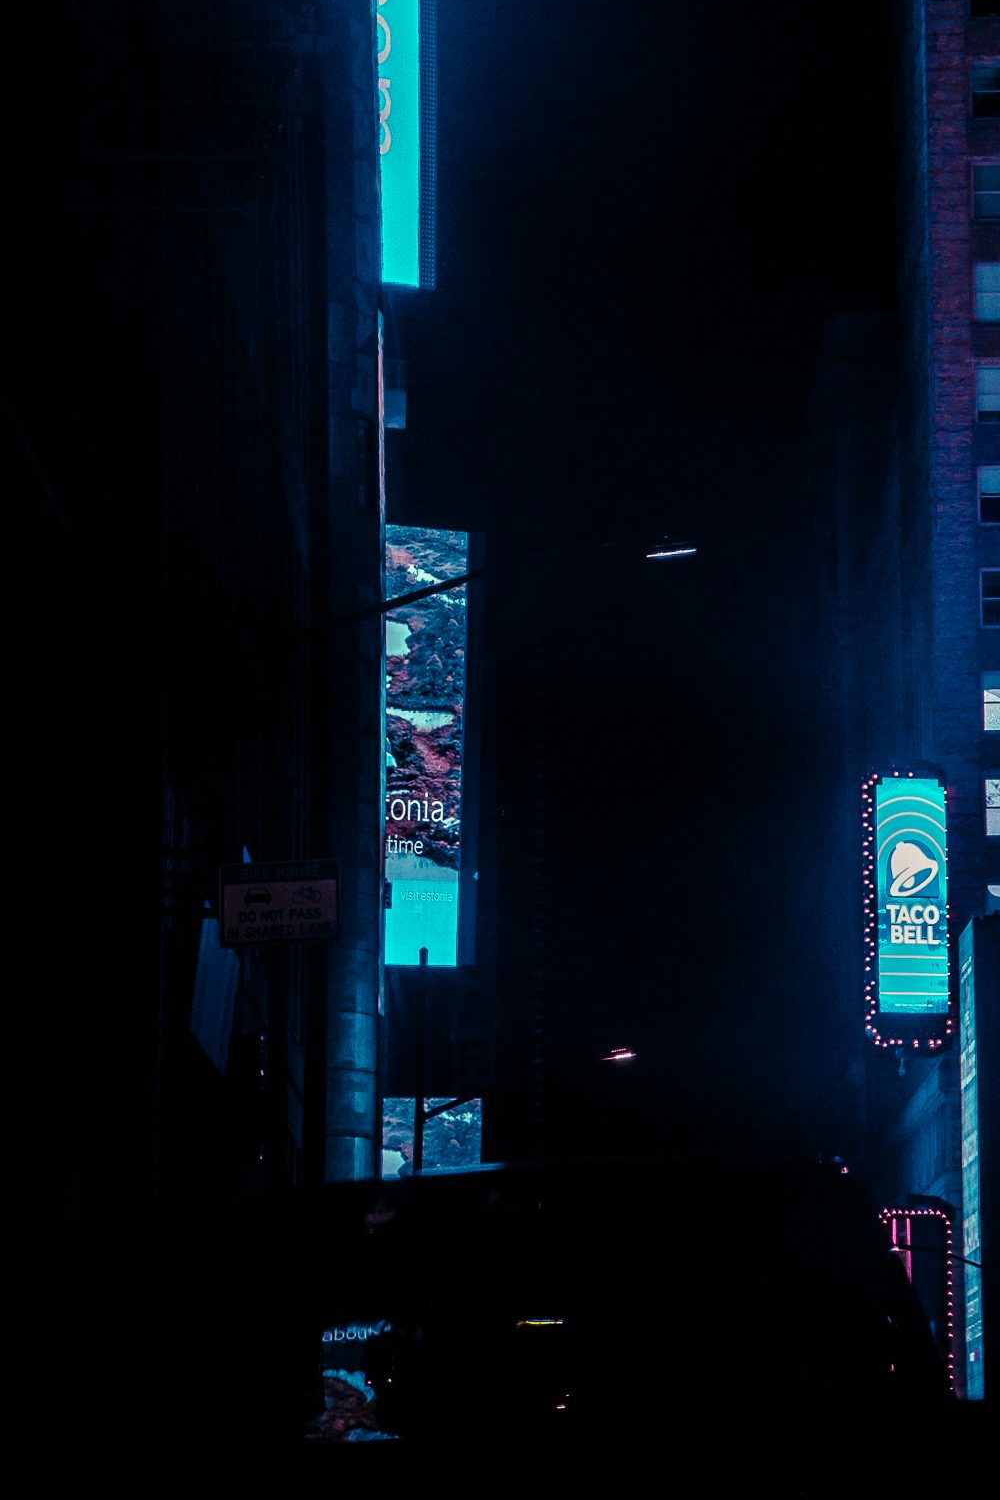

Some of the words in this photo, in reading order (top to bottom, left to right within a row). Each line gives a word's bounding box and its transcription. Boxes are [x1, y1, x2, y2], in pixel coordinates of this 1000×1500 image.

[386, 835, 424, 854] time
[240, 912, 256, 923] DO
[260, 910, 283, 921] NOT
[289, 907, 322, 919] PASS
[886, 904, 940, 925] TACO
[244, 924, 296, 938] SHARED
[891, 925, 941, 944] BELL
